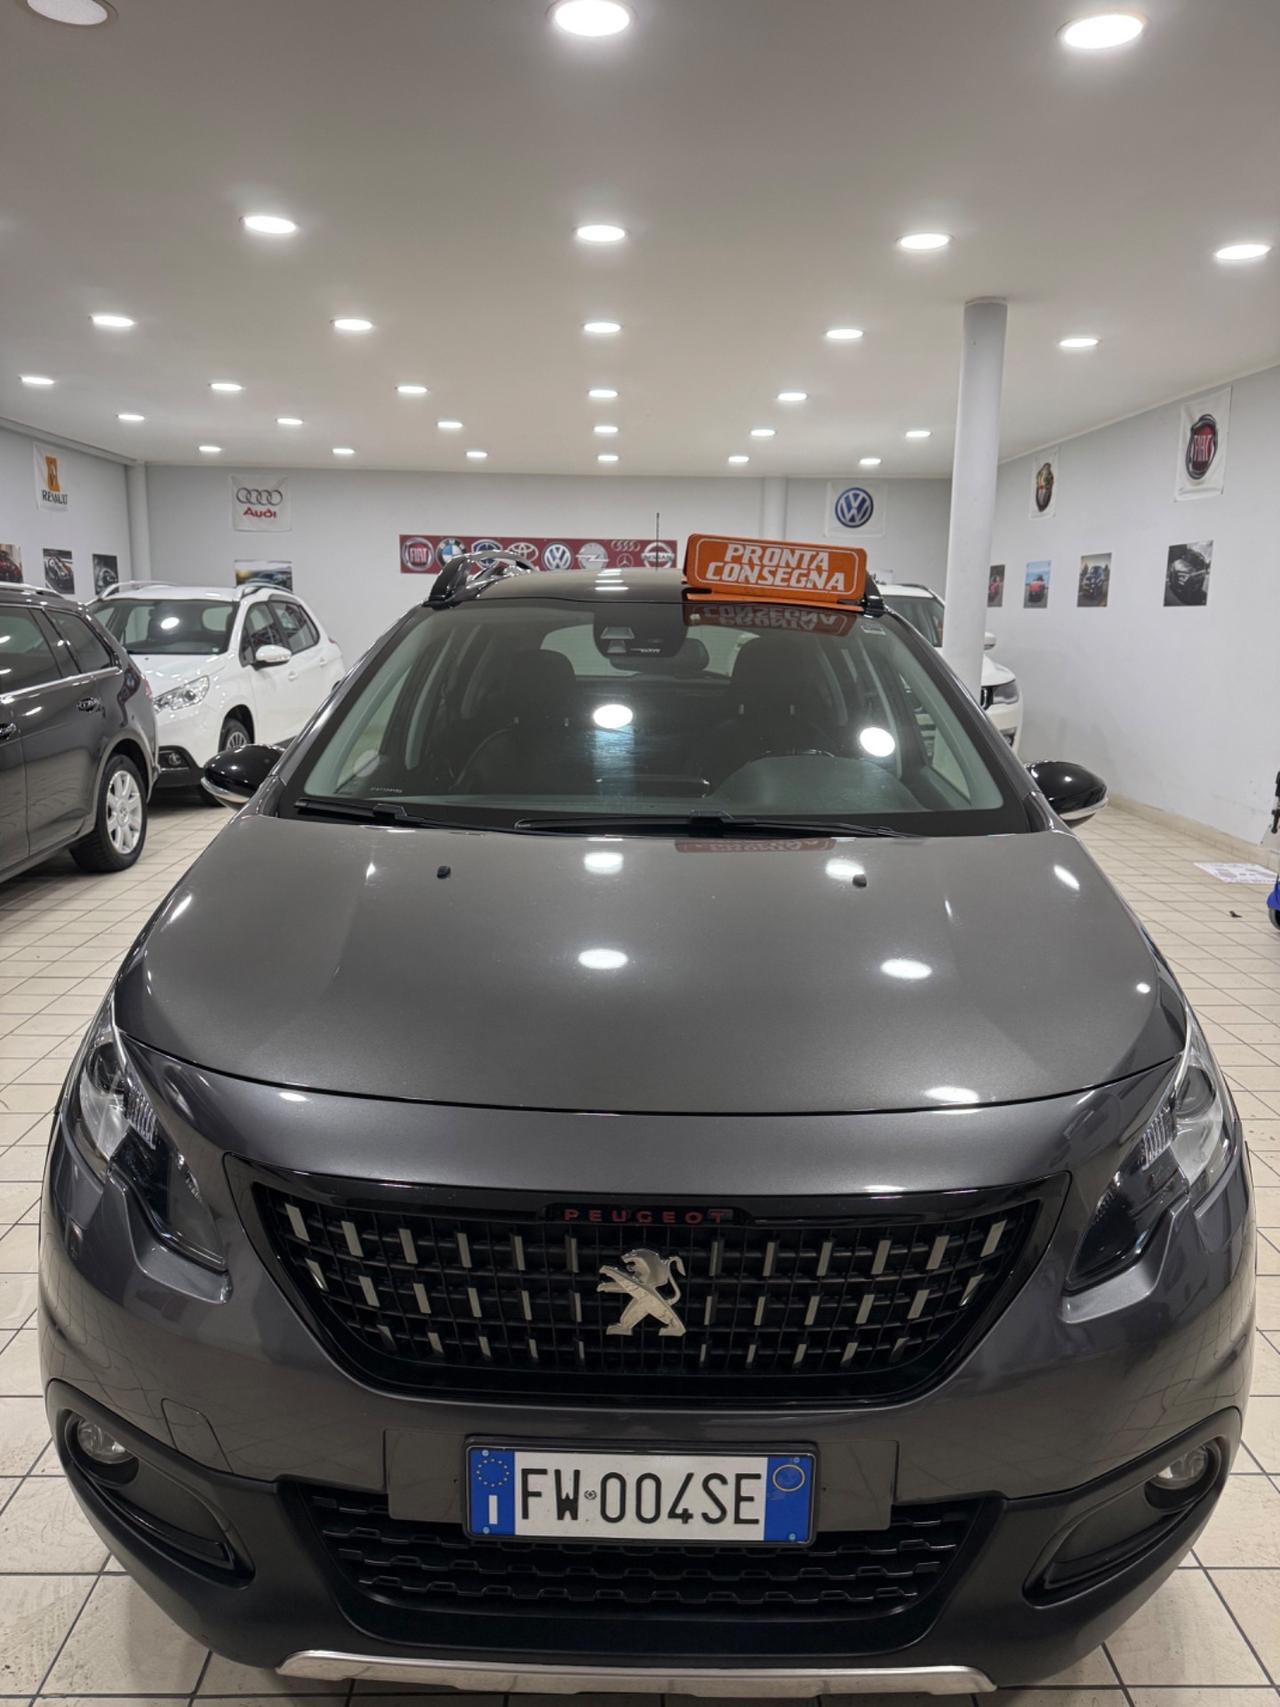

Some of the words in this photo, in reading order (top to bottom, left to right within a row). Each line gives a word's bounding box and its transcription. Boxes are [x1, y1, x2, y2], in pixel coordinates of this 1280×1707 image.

[243, 506, 277, 519] Audi
[410, 547, 428, 563] FIAT
[724, 543, 830, 570] PRONTA
[705, 561, 845, 592] CONSEGNA
[563, 1208, 724, 1225] PEUGEOT
